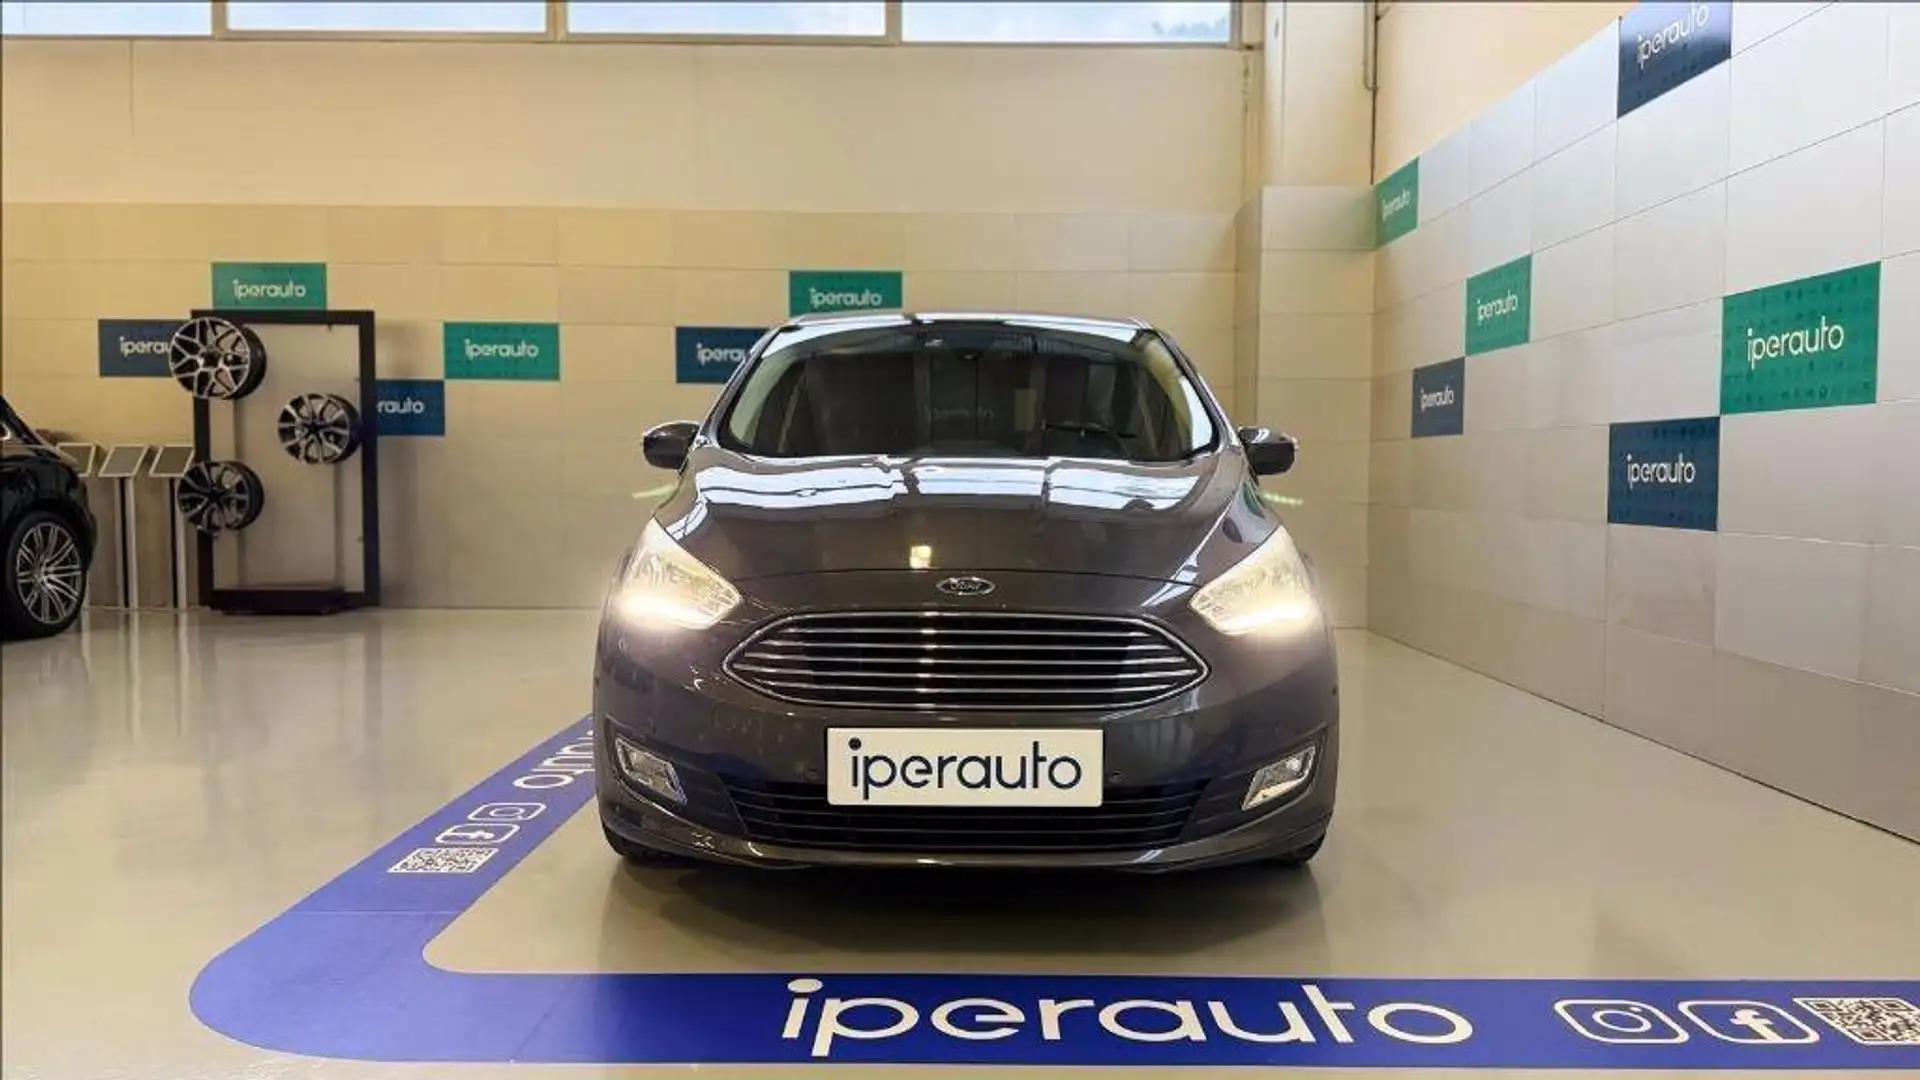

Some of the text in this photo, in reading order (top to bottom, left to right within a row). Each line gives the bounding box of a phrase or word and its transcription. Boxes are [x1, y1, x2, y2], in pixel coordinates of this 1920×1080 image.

[1636, 0, 1709, 70] iperauto
[233, 279, 307, 299] iperauto
[810, 288, 883, 308] iperauto
[1477, 289, 1518, 326] iperauto
[464, 338, 540, 360] iperauto
[1747, 316, 1845, 370] iperauto
[377, 396, 425, 414] rauto
[1421, 385, 1454, 412] iperauto
[1627, 453, 1696, 489] iperauto
[847, 737, 1083, 800] iperauto
[781, 978, 1474, 1057] iperauto
